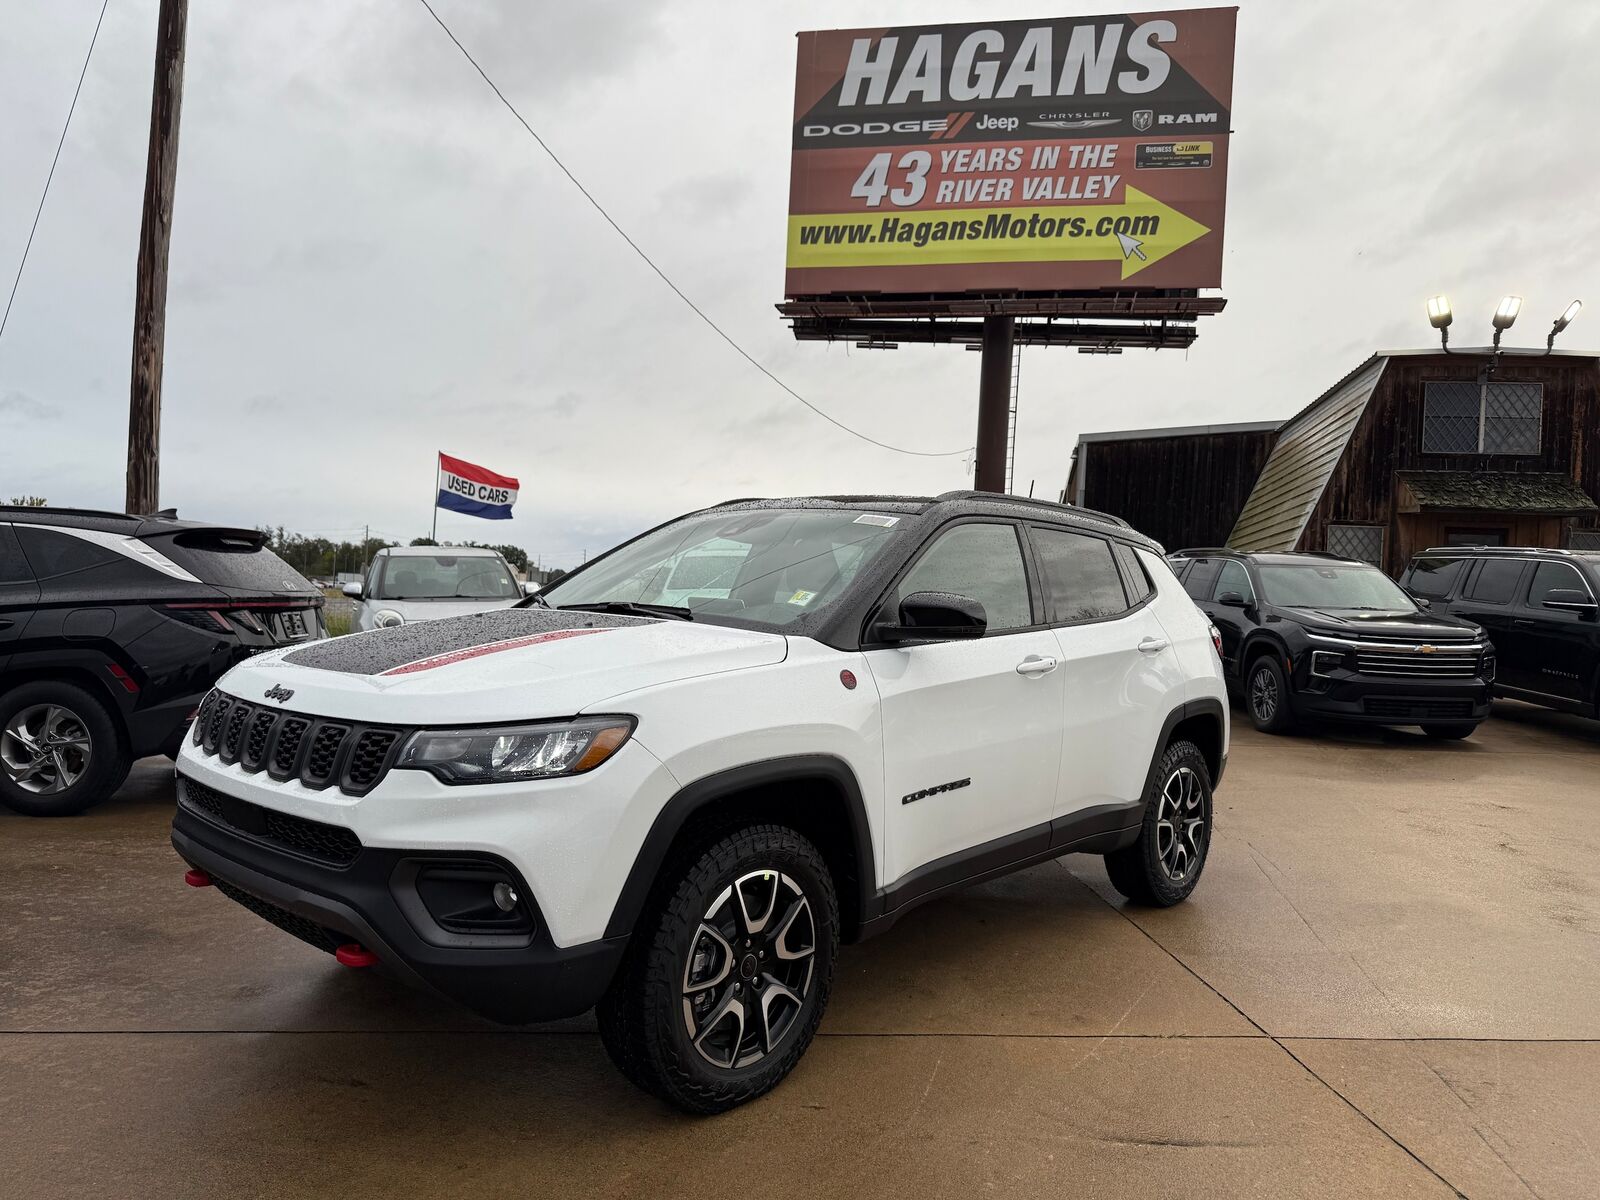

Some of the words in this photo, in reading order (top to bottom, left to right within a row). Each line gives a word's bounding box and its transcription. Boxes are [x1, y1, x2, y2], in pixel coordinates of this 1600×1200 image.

[838, 19, 1177, 107] HAGANS
[803, 119, 948, 137] DODGE
[976, 114, 1019, 131] Jeep
[1039, 111, 1110, 120] CHRYSLER
[1158, 112, 1217, 125] RAM
[941, 147, 1023, 173] YEARS
[1030, 145, 1060, 170] IN
[1068, 144, 1119, 168] THE
[1145, 145, 1172, 153] BUSINESS
[851, 150, 932, 207] 43
[935, 177, 1014, 204] RIVER
[1022, 174, 1121, 201] VALLEY
[800, 212, 1160, 247] www.HagansMotors.com
[447, 474, 475, 496] USED
[478, 486, 509, 503] CARS
[264, 683, 295, 704] Jeep
[901, 777, 971, 805] COMPASS
